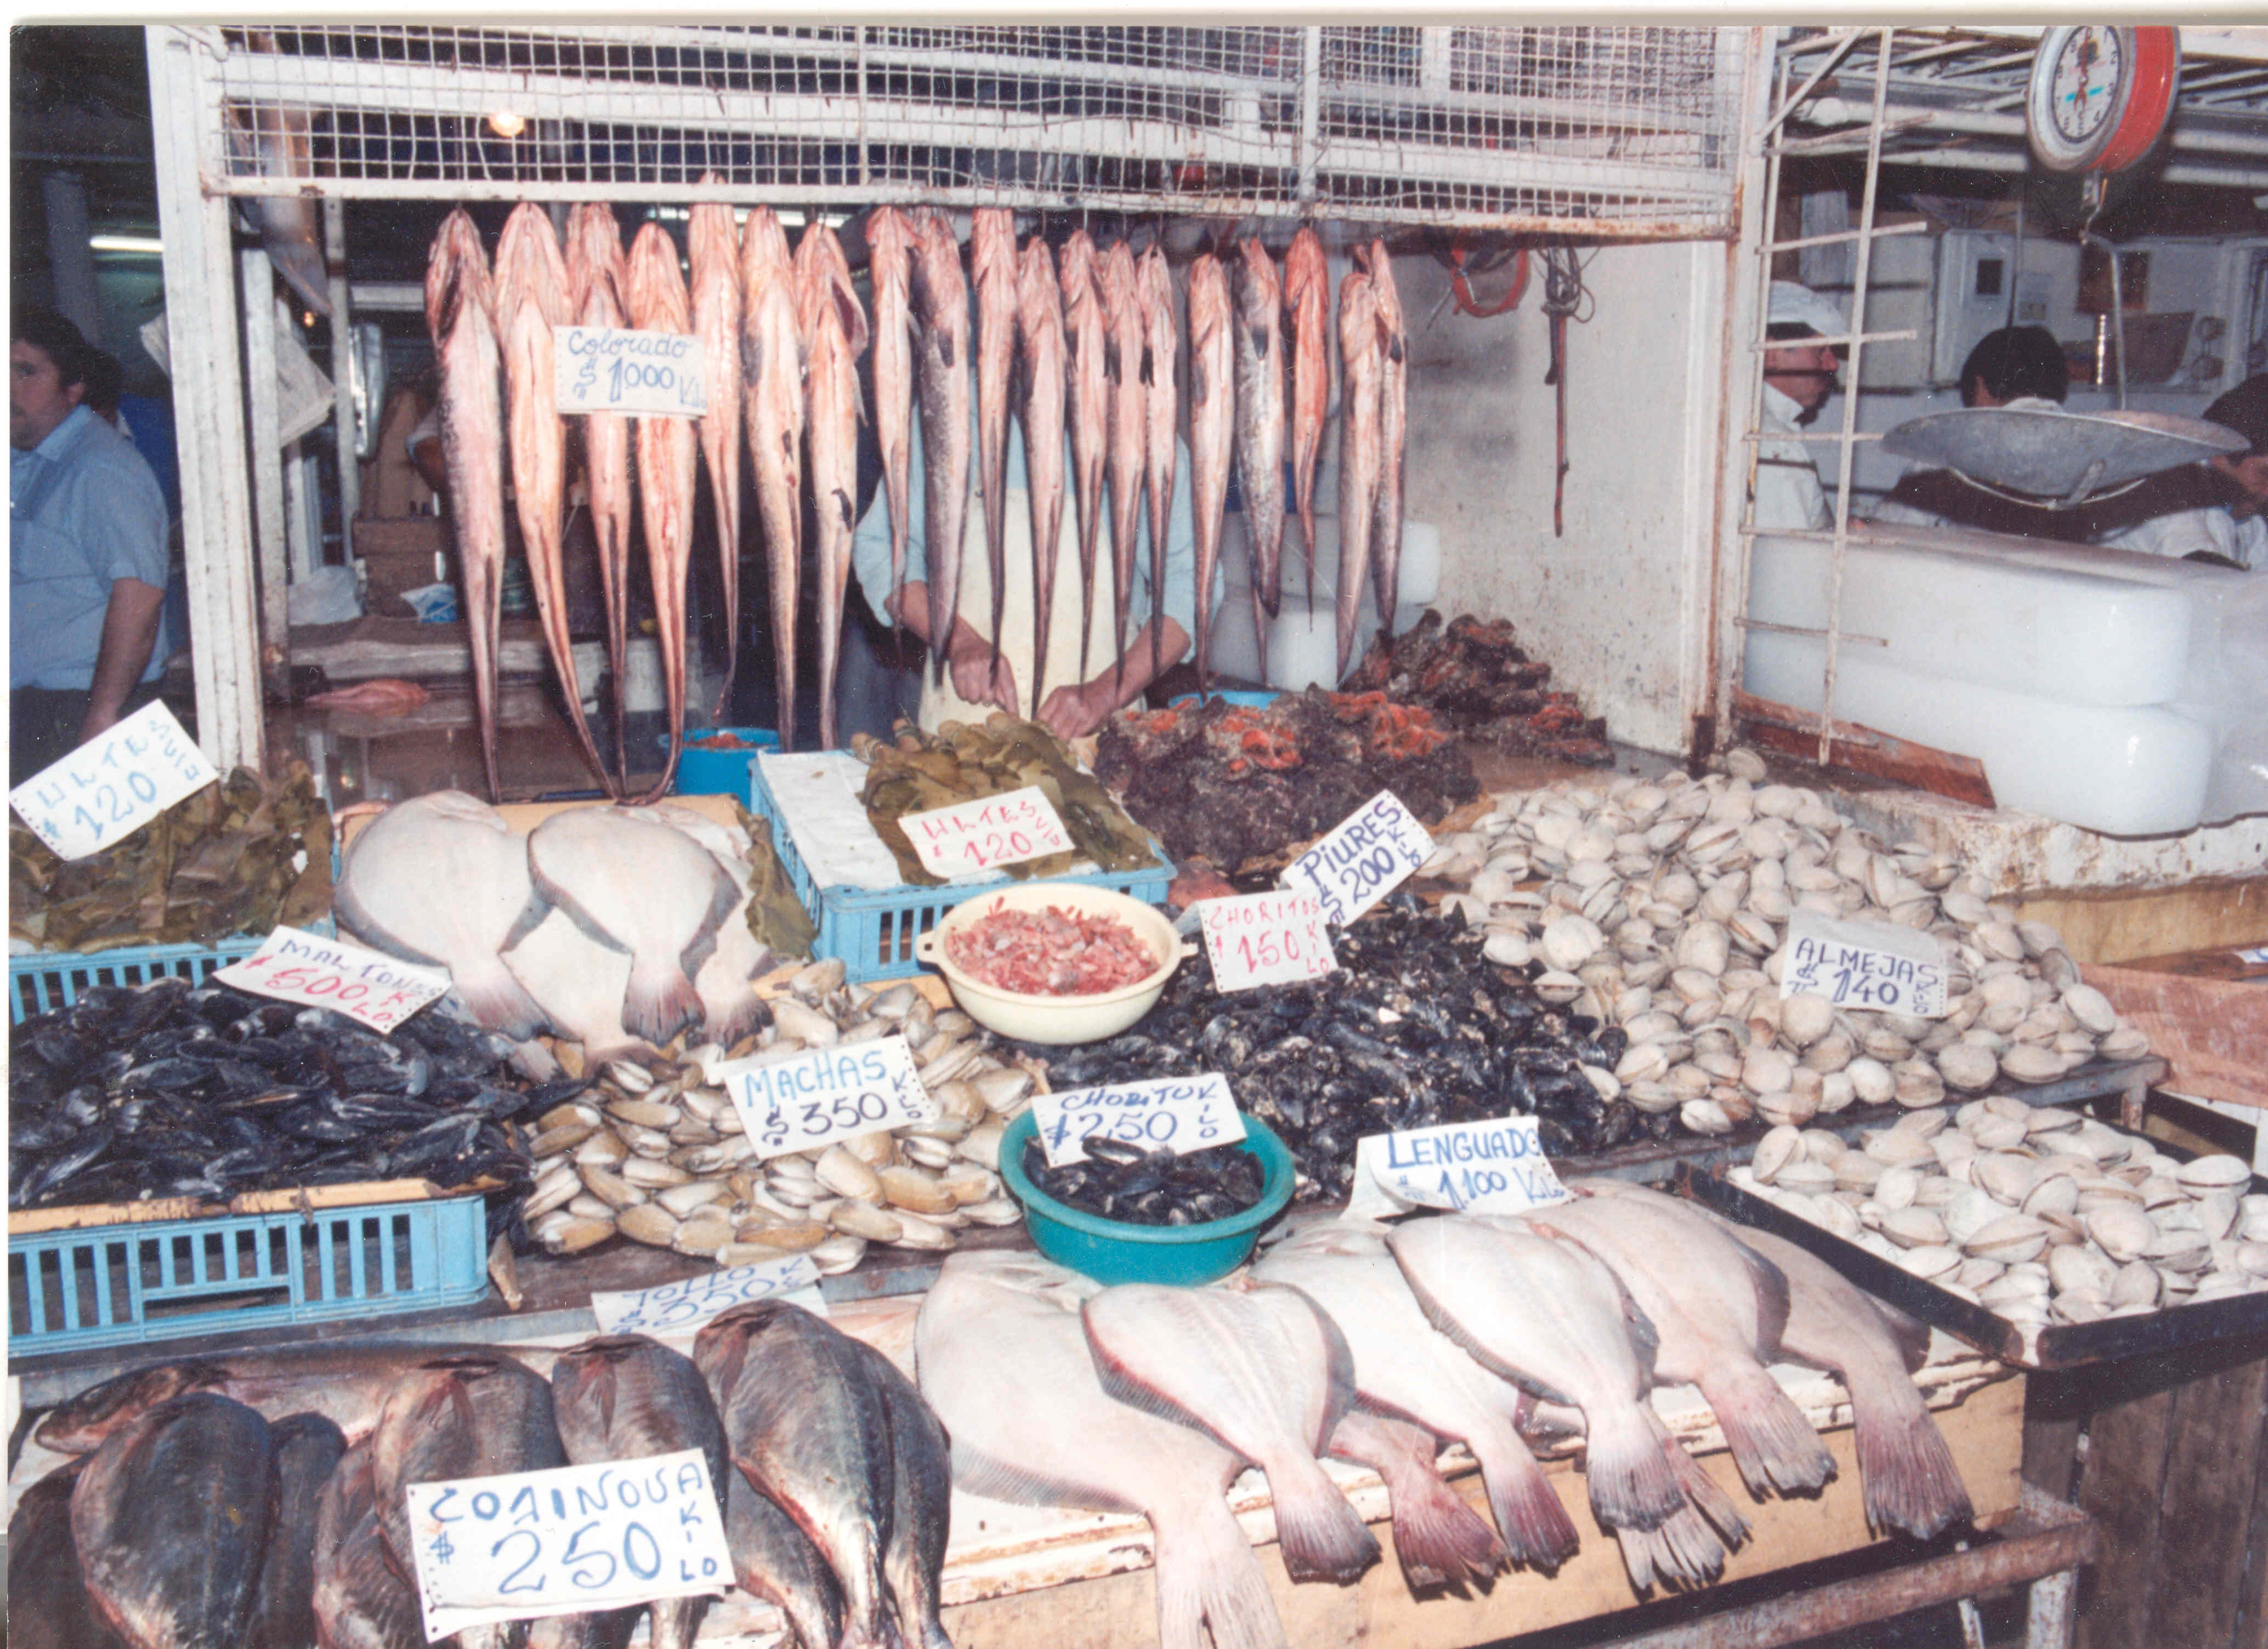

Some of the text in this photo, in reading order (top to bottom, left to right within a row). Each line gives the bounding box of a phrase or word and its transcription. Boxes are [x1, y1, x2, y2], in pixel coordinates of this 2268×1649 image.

[569, 328, 694, 359] Colorado
[74, 771, 157, 843] 120
[963, 831, 1032, 867] 120
[1340, 846, 1395, 905] 200
[1210, 894, 1320, 930] CHORITOS
[1238, 930, 1300, 974] 150
[1795, 937, 1938, 985] ALMEJAS
[1832, 968, 1900, 1005] 140
[744, 1050, 887, 1108] MACHAS
[799, 1092, 888, 1135] 350
[1387, 1128, 1544, 1170] LENGUADO
[492, 1521, 661, 1594] 250
